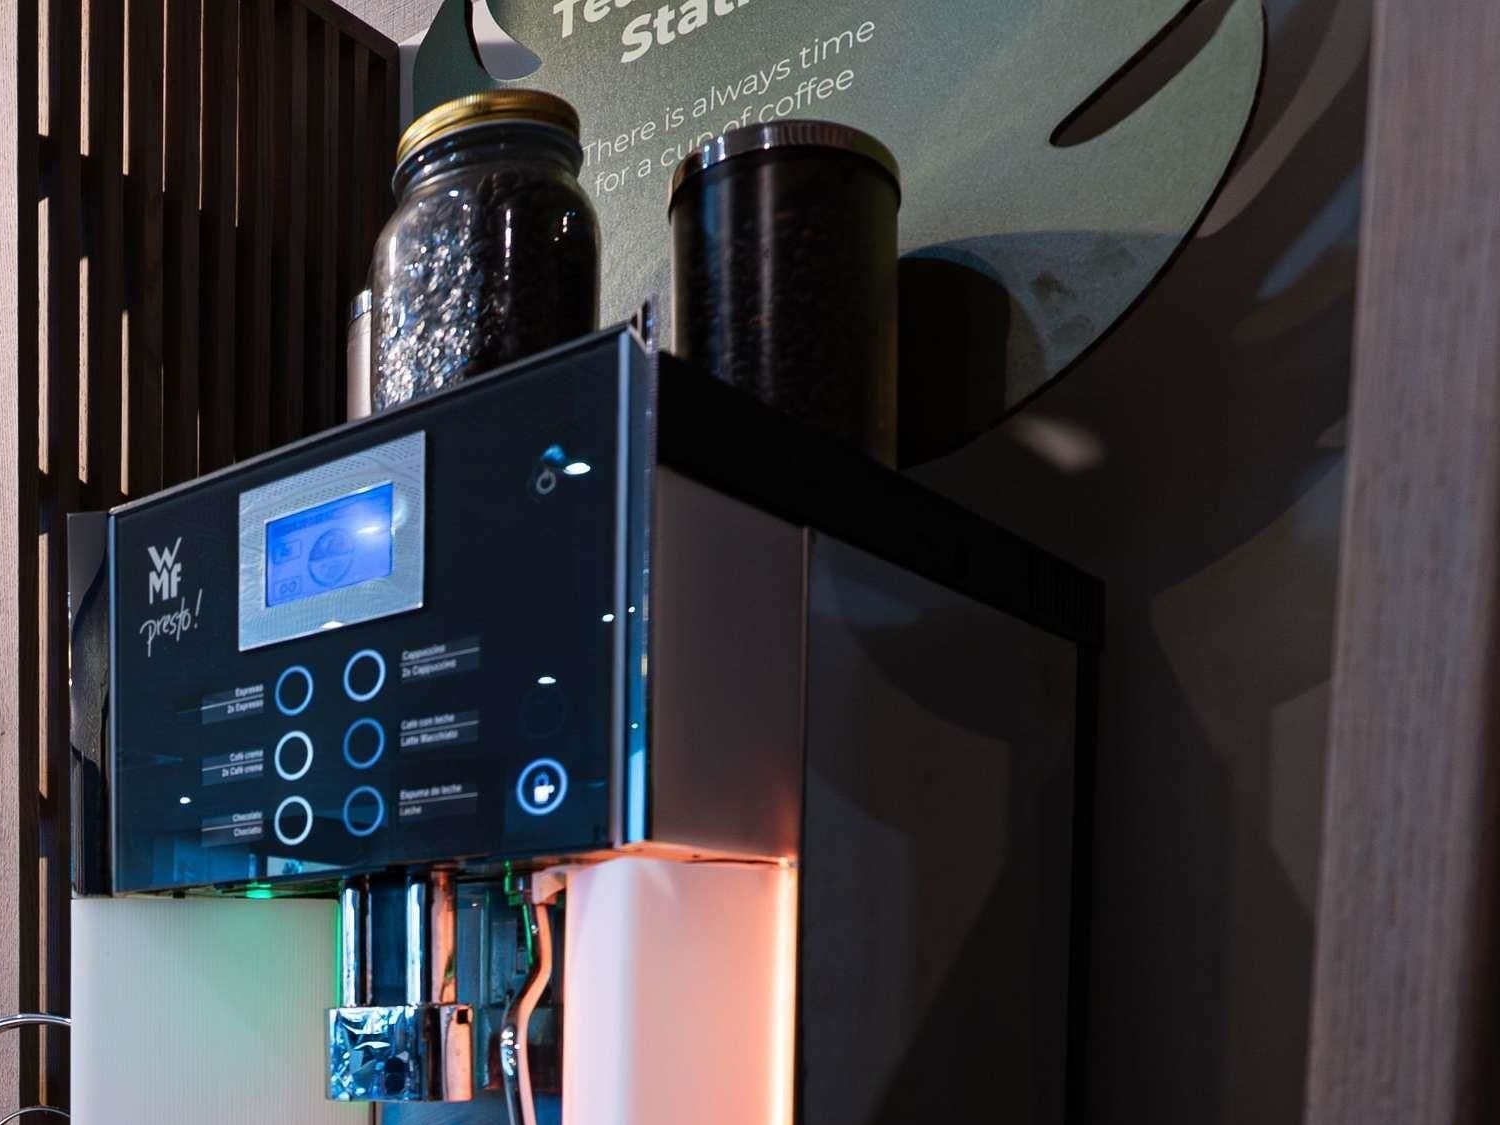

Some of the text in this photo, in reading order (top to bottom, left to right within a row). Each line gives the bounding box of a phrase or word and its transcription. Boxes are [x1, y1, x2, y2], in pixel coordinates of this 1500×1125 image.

[553, 0, 636, 38] Te
[582, 20, 876, 167] There is always time
[595, 166, 630, 197] for
[637, 158, 651, 178] a
[758, 68, 855, 122] coffee
[139, 587, 203, 658] presto!
